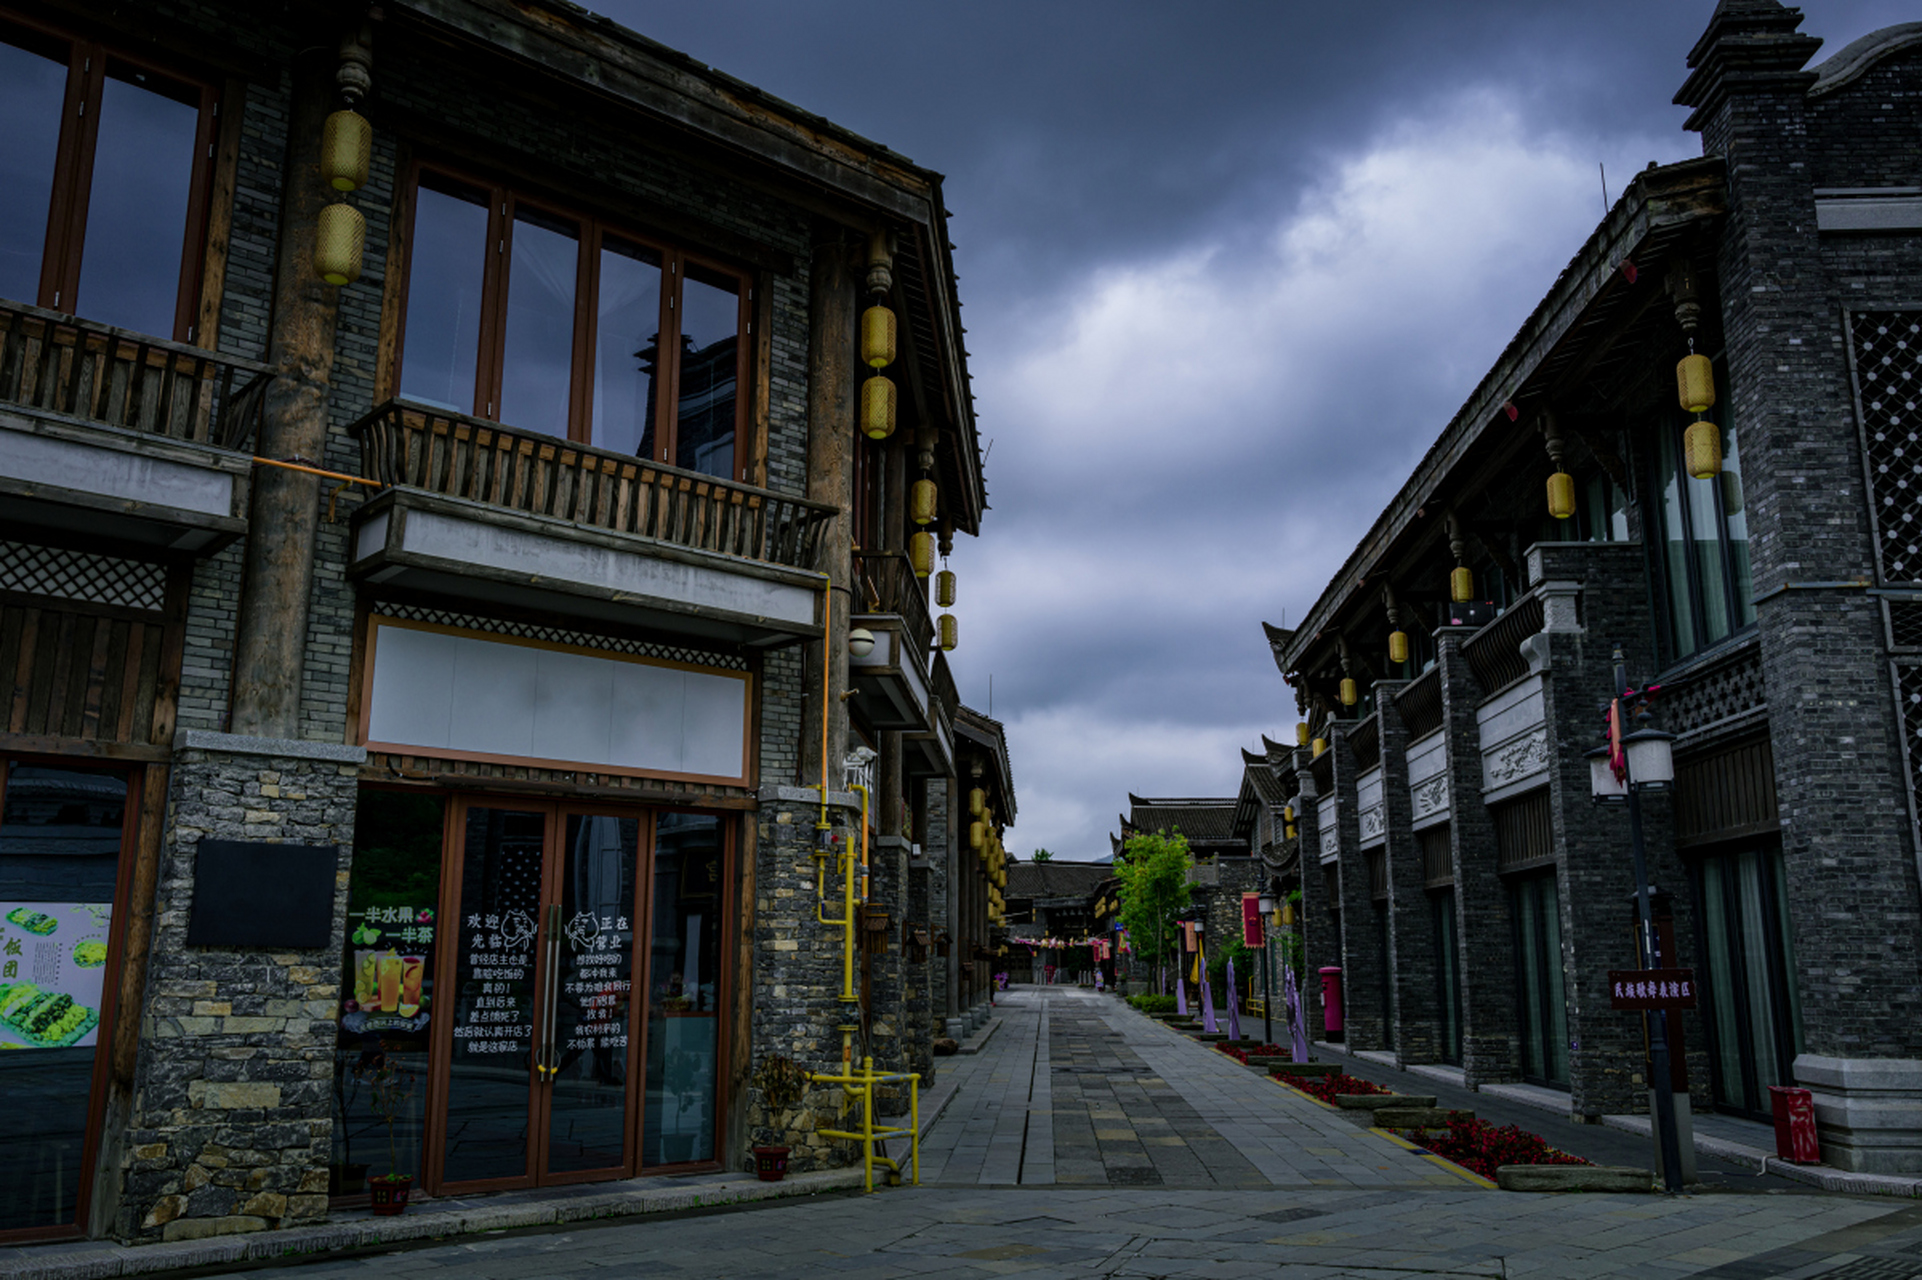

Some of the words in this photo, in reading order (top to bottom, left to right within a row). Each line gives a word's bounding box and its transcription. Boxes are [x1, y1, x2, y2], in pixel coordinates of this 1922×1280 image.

[348, 905, 414, 924] 一半水果
[467, 913, 500, 930] 欢迎
[600, 916, 629, 931] 正在
[385, 926, 434, 944] 一半茶
[470, 933, 503, 950] 光临
[596, 935, 623, 951] 营业
[2, 937, 23, 979] 饭团
[475, 996, 517, 1009] 直到后来
